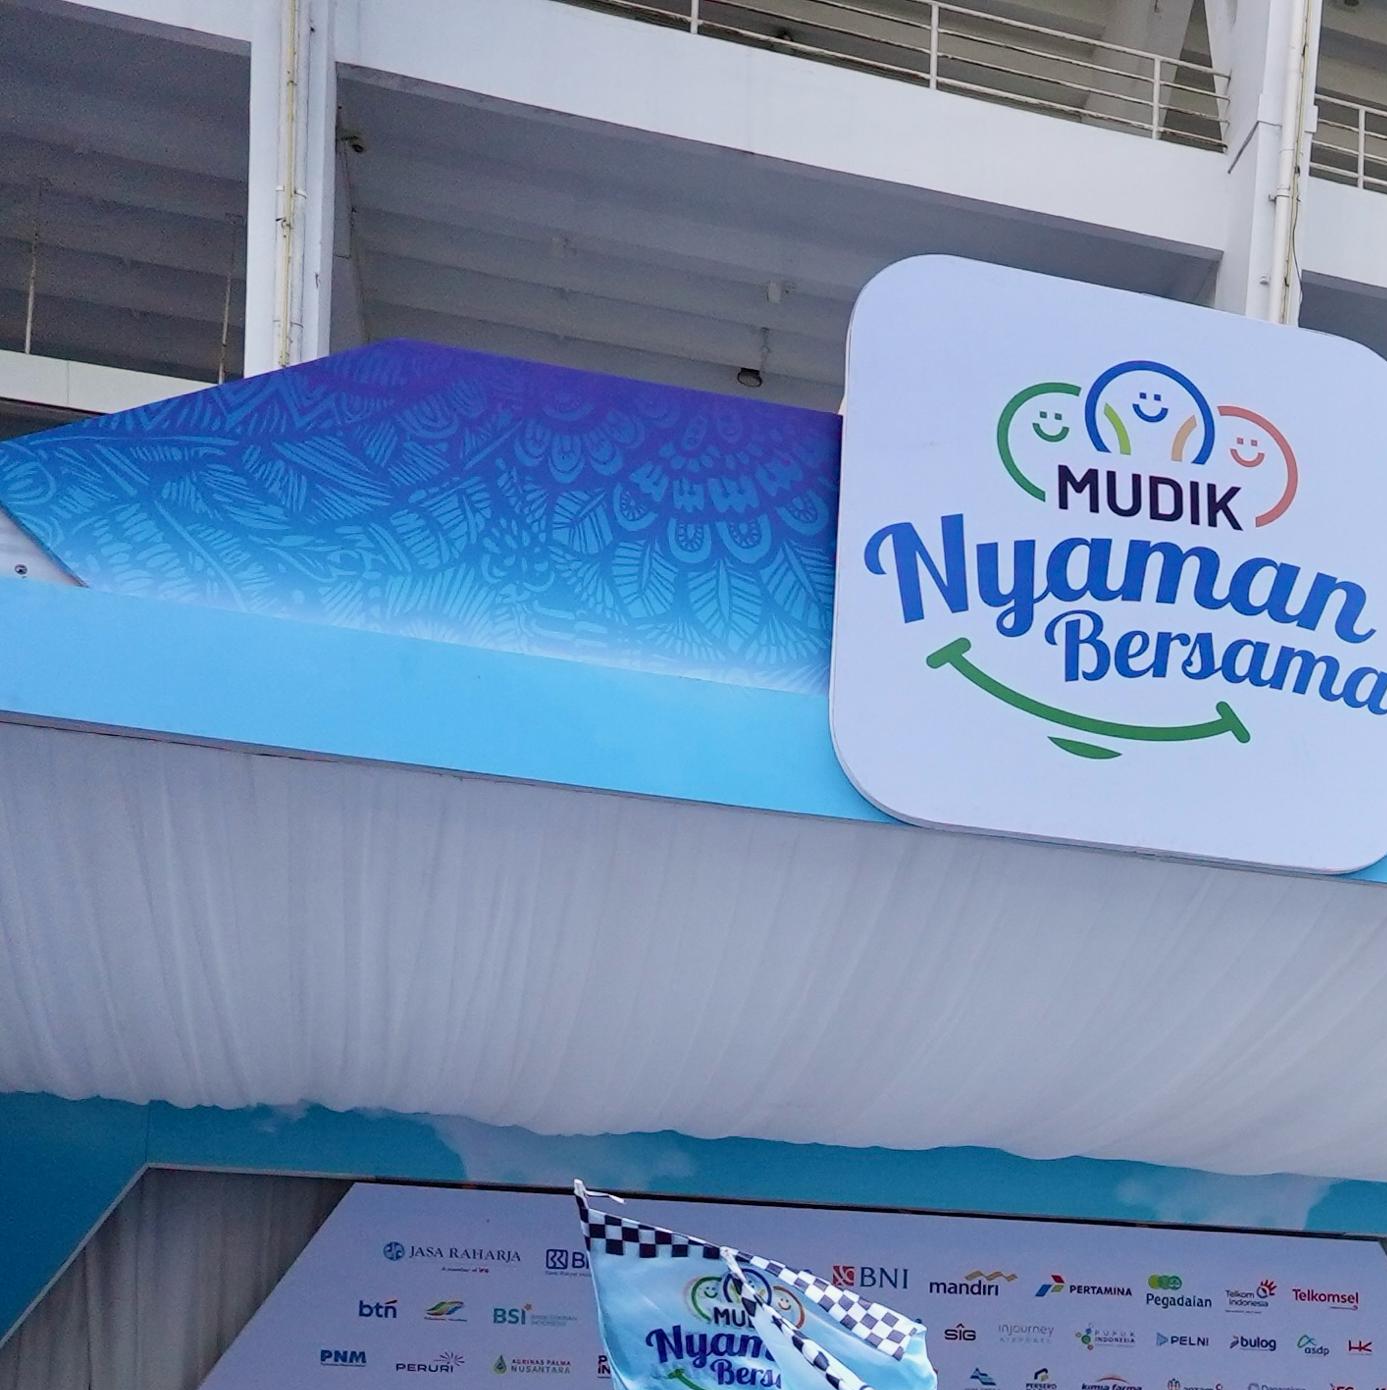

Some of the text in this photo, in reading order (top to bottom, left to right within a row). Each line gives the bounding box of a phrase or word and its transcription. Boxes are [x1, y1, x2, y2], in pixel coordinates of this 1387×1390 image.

[1058, 463, 1244, 531] MUDIK
[864, 513, 1376, 644] Nyaman
[409, 1246, 521, 1263] JASA RAHARJA
[860, 1267, 908, 1289] BNI
[929, 1280, 999, 1297] mandiri
[1069, 1284, 1132, 1297] PERTAMINA
[1225, 1289, 1254, 1299] Telkom
[1146, 1293, 1212, 1309] Pegadaian
[1229, 1299, 1268, 1307] Indonesia
[1292, 1289, 1358, 1304] Telkomsel
[359, 1300, 397, 1318] btn
[493, 1308, 526, 1325] BSI
[645, 1325, 774, 1368] Nyam
[1171, 1335, 1209, 1347] PELNI
[1240, 1336, 1276, 1351] bulog
[321, 1350, 366, 1364] PNM
[1304, 1346, 1329, 1356] asdp
[396, 1359, 453, 1373] PERURI
[511, 1366, 570, 1374] NUSANTARA
[710, 1359, 781, 1389] Bers
